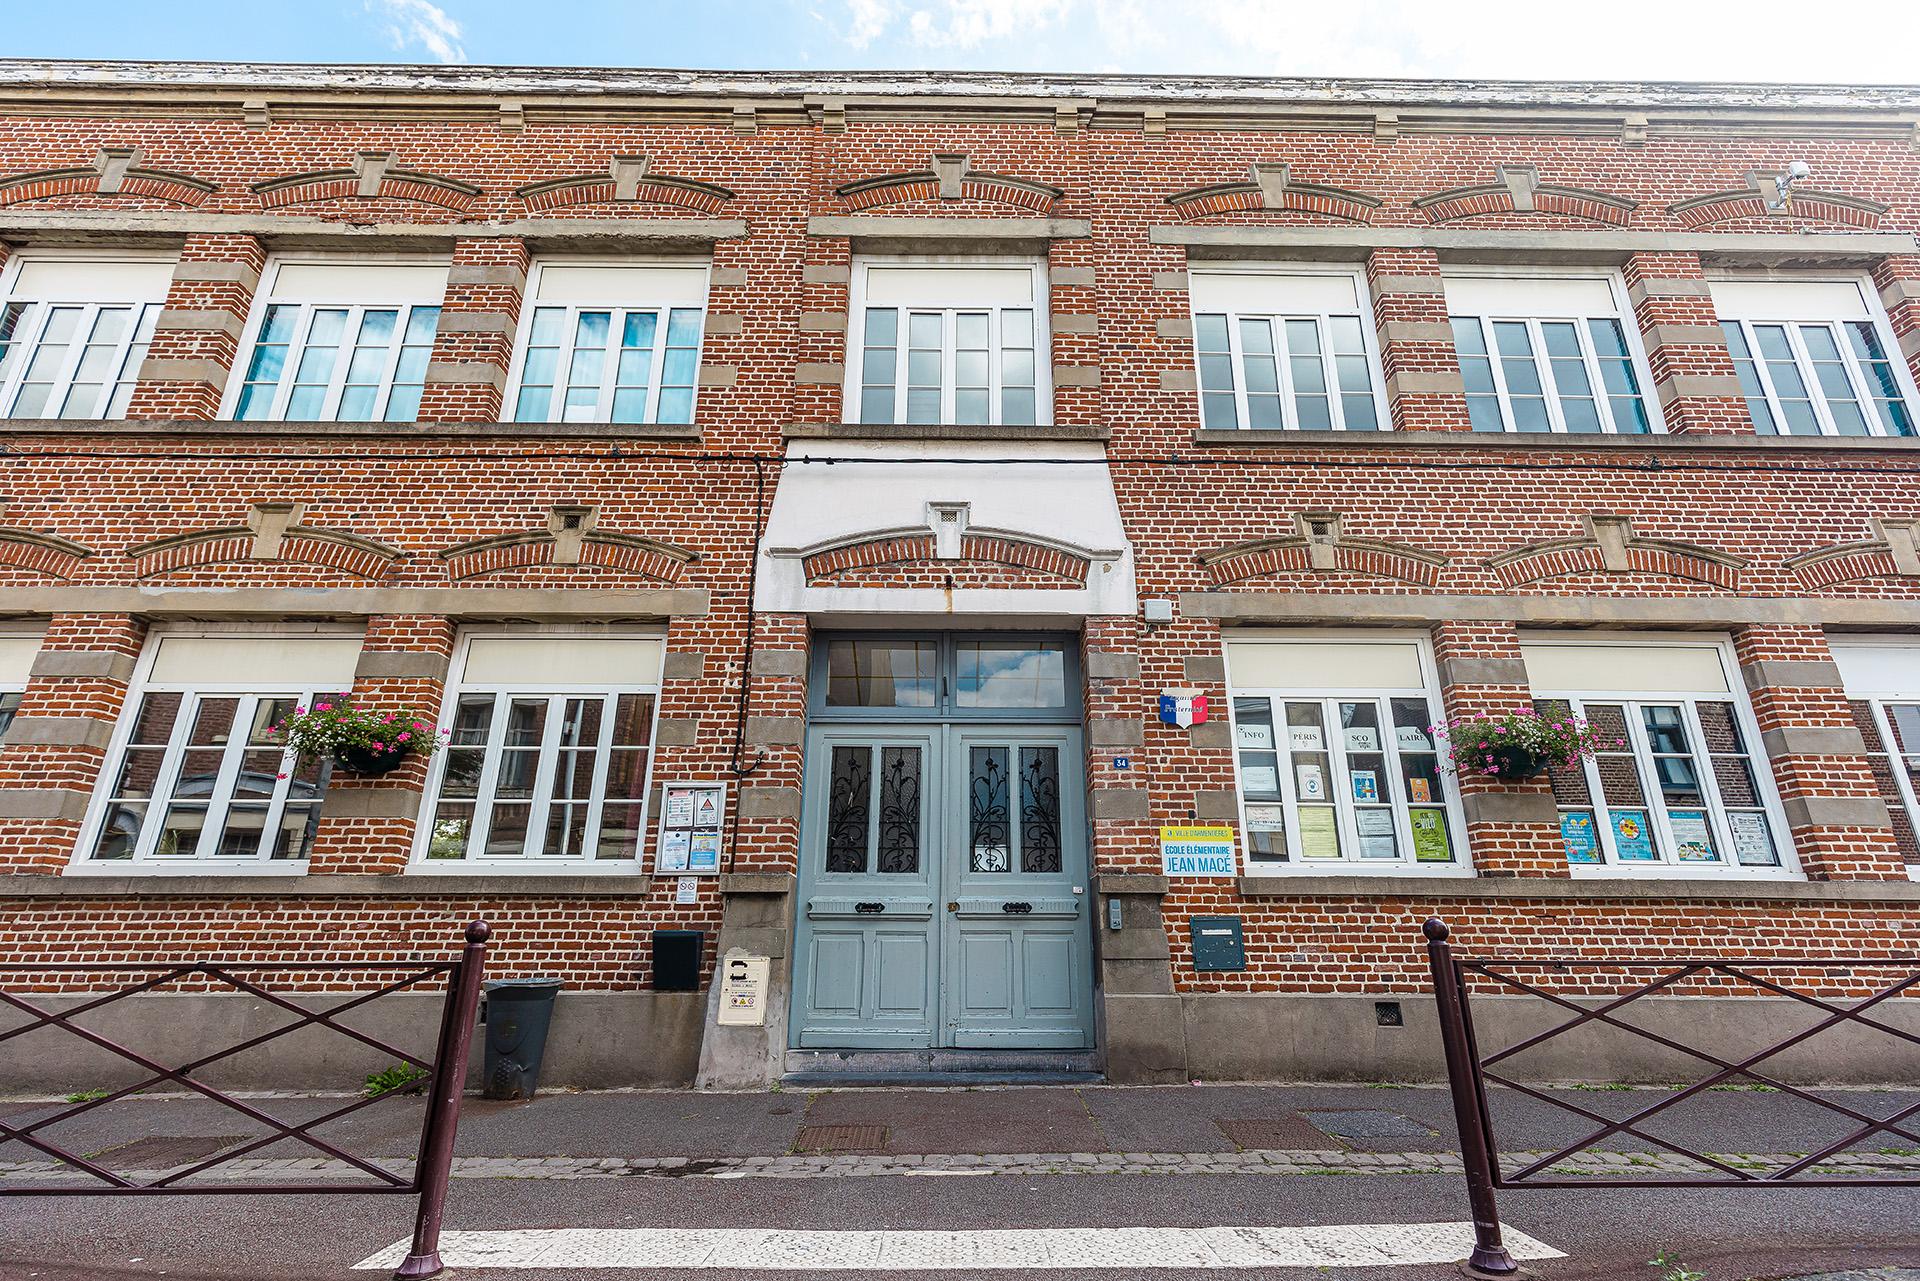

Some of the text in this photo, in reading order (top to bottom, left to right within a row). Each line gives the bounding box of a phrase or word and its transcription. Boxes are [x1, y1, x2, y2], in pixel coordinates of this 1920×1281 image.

[1244, 731, 1265, 739] INFO
[1351, 734, 1369, 742] SCO
[1116, 759, 1126, 767] 34
[1165, 844, 1231, 855] ÉCOLE ÉLÉMENTAIRE
[1167, 855, 1232, 873] JEAN MACÉ
